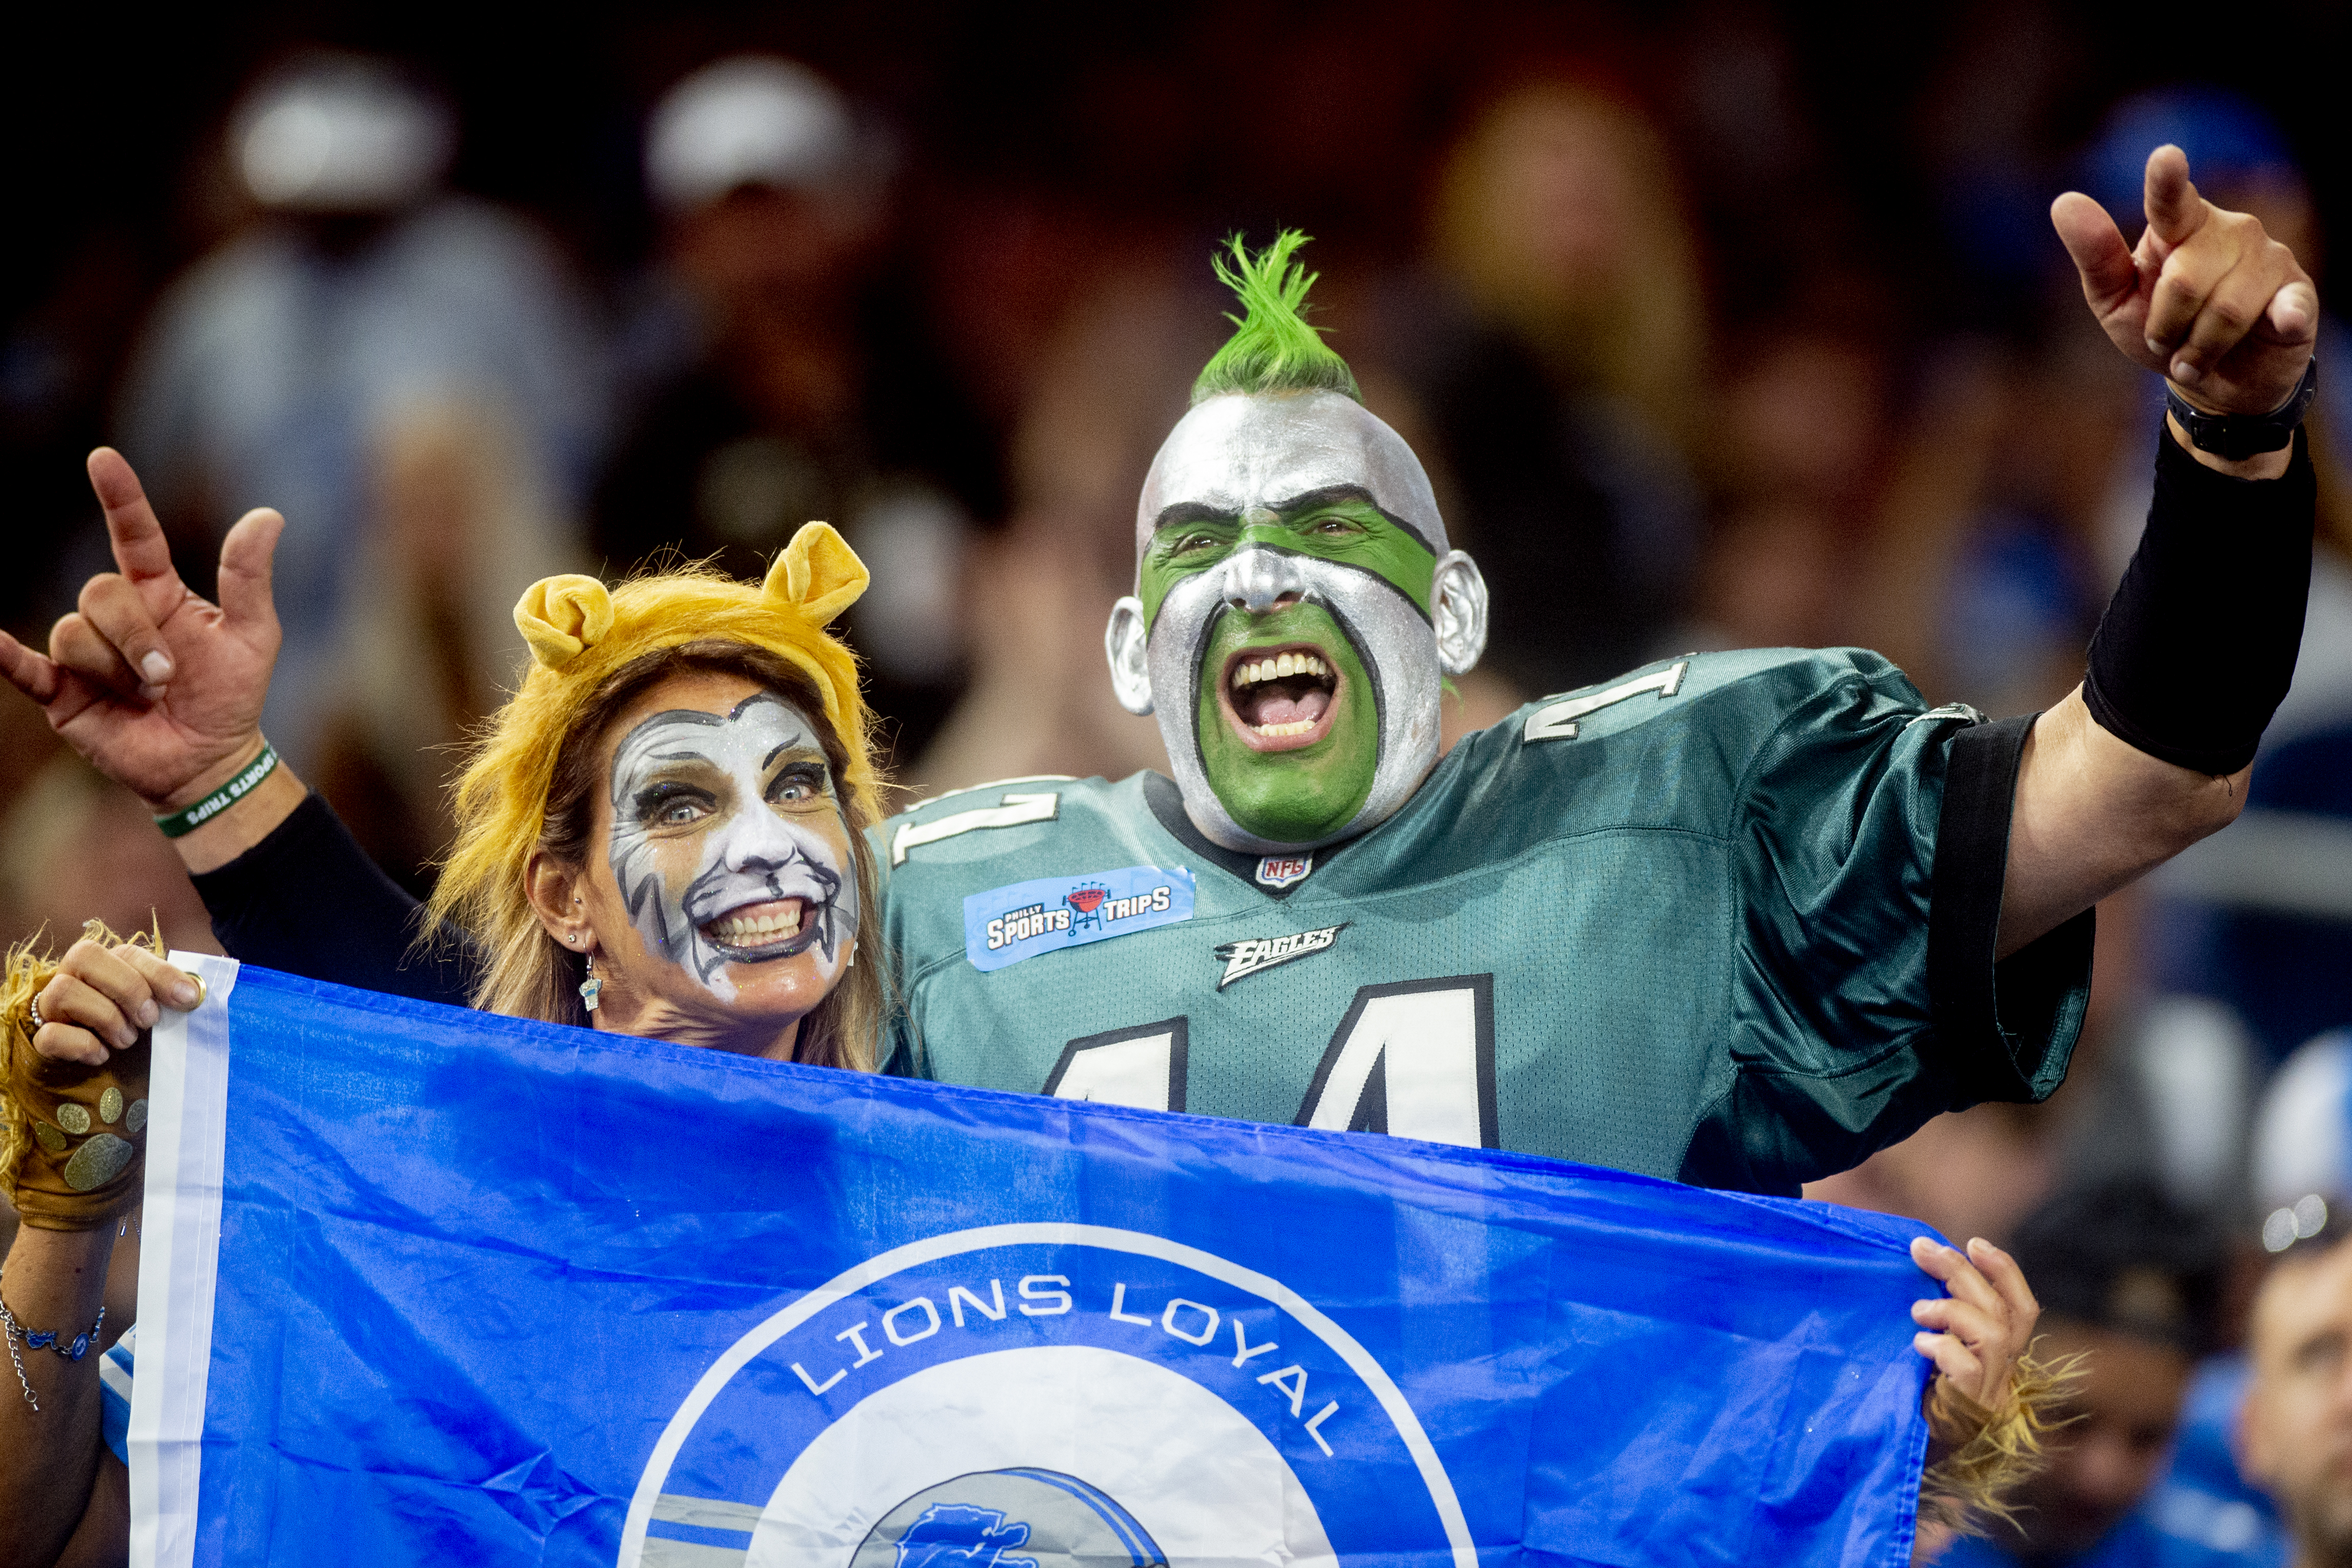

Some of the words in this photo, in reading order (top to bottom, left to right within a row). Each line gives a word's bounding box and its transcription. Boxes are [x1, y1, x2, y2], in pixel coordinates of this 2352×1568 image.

[185, 792, 231, 825] TRIPS
[1266, 858, 1304, 878] NFL
[987, 909, 1071, 951] SPORTS
[1103, 886, 1171, 922] TRIPS
[1004, 904, 1042, 922] PHILLY
[1221, 926, 1342, 986] EAGLES
[791, 1274, 1073, 1397] LIONS
[1109, 1281, 1340, 1458] LOYAL
